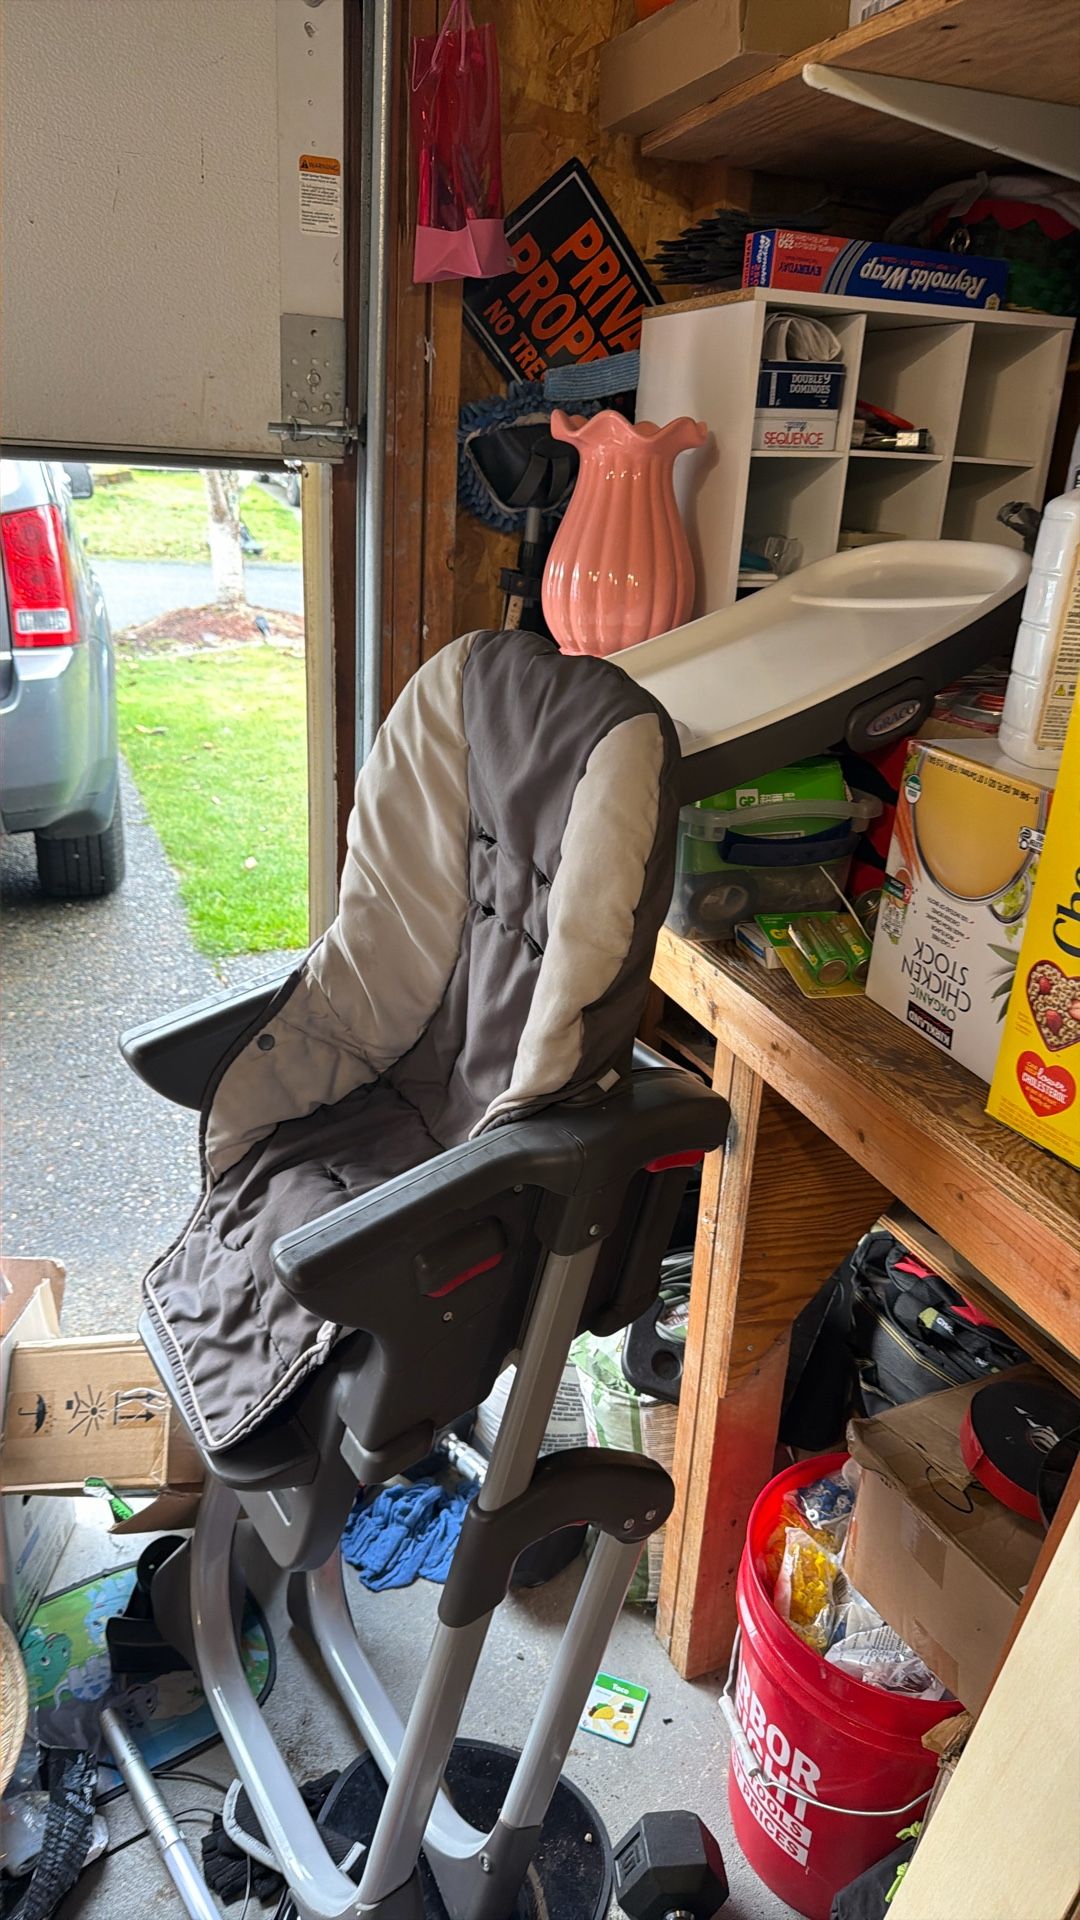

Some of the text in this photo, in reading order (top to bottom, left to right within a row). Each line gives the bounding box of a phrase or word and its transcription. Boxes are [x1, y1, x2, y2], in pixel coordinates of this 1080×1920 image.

[860, 256, 987, 300] Reynolds Wrap
[482, 299, 548, 384] NO TRE
[789, 384, 831, 394] DOMINOES
[764, 432, 824, 446] SEQUENCE
[738, 794, 756, 807] GP
[901, 955, 971, 1012] CHICKEN
[913, 938, 969, 986] STOCK
[909, 983, 956, 1021] ORGANIC
[741, 1660, 821, 1798] RBOR
[742, 1783, 799, 1857] PRICES
